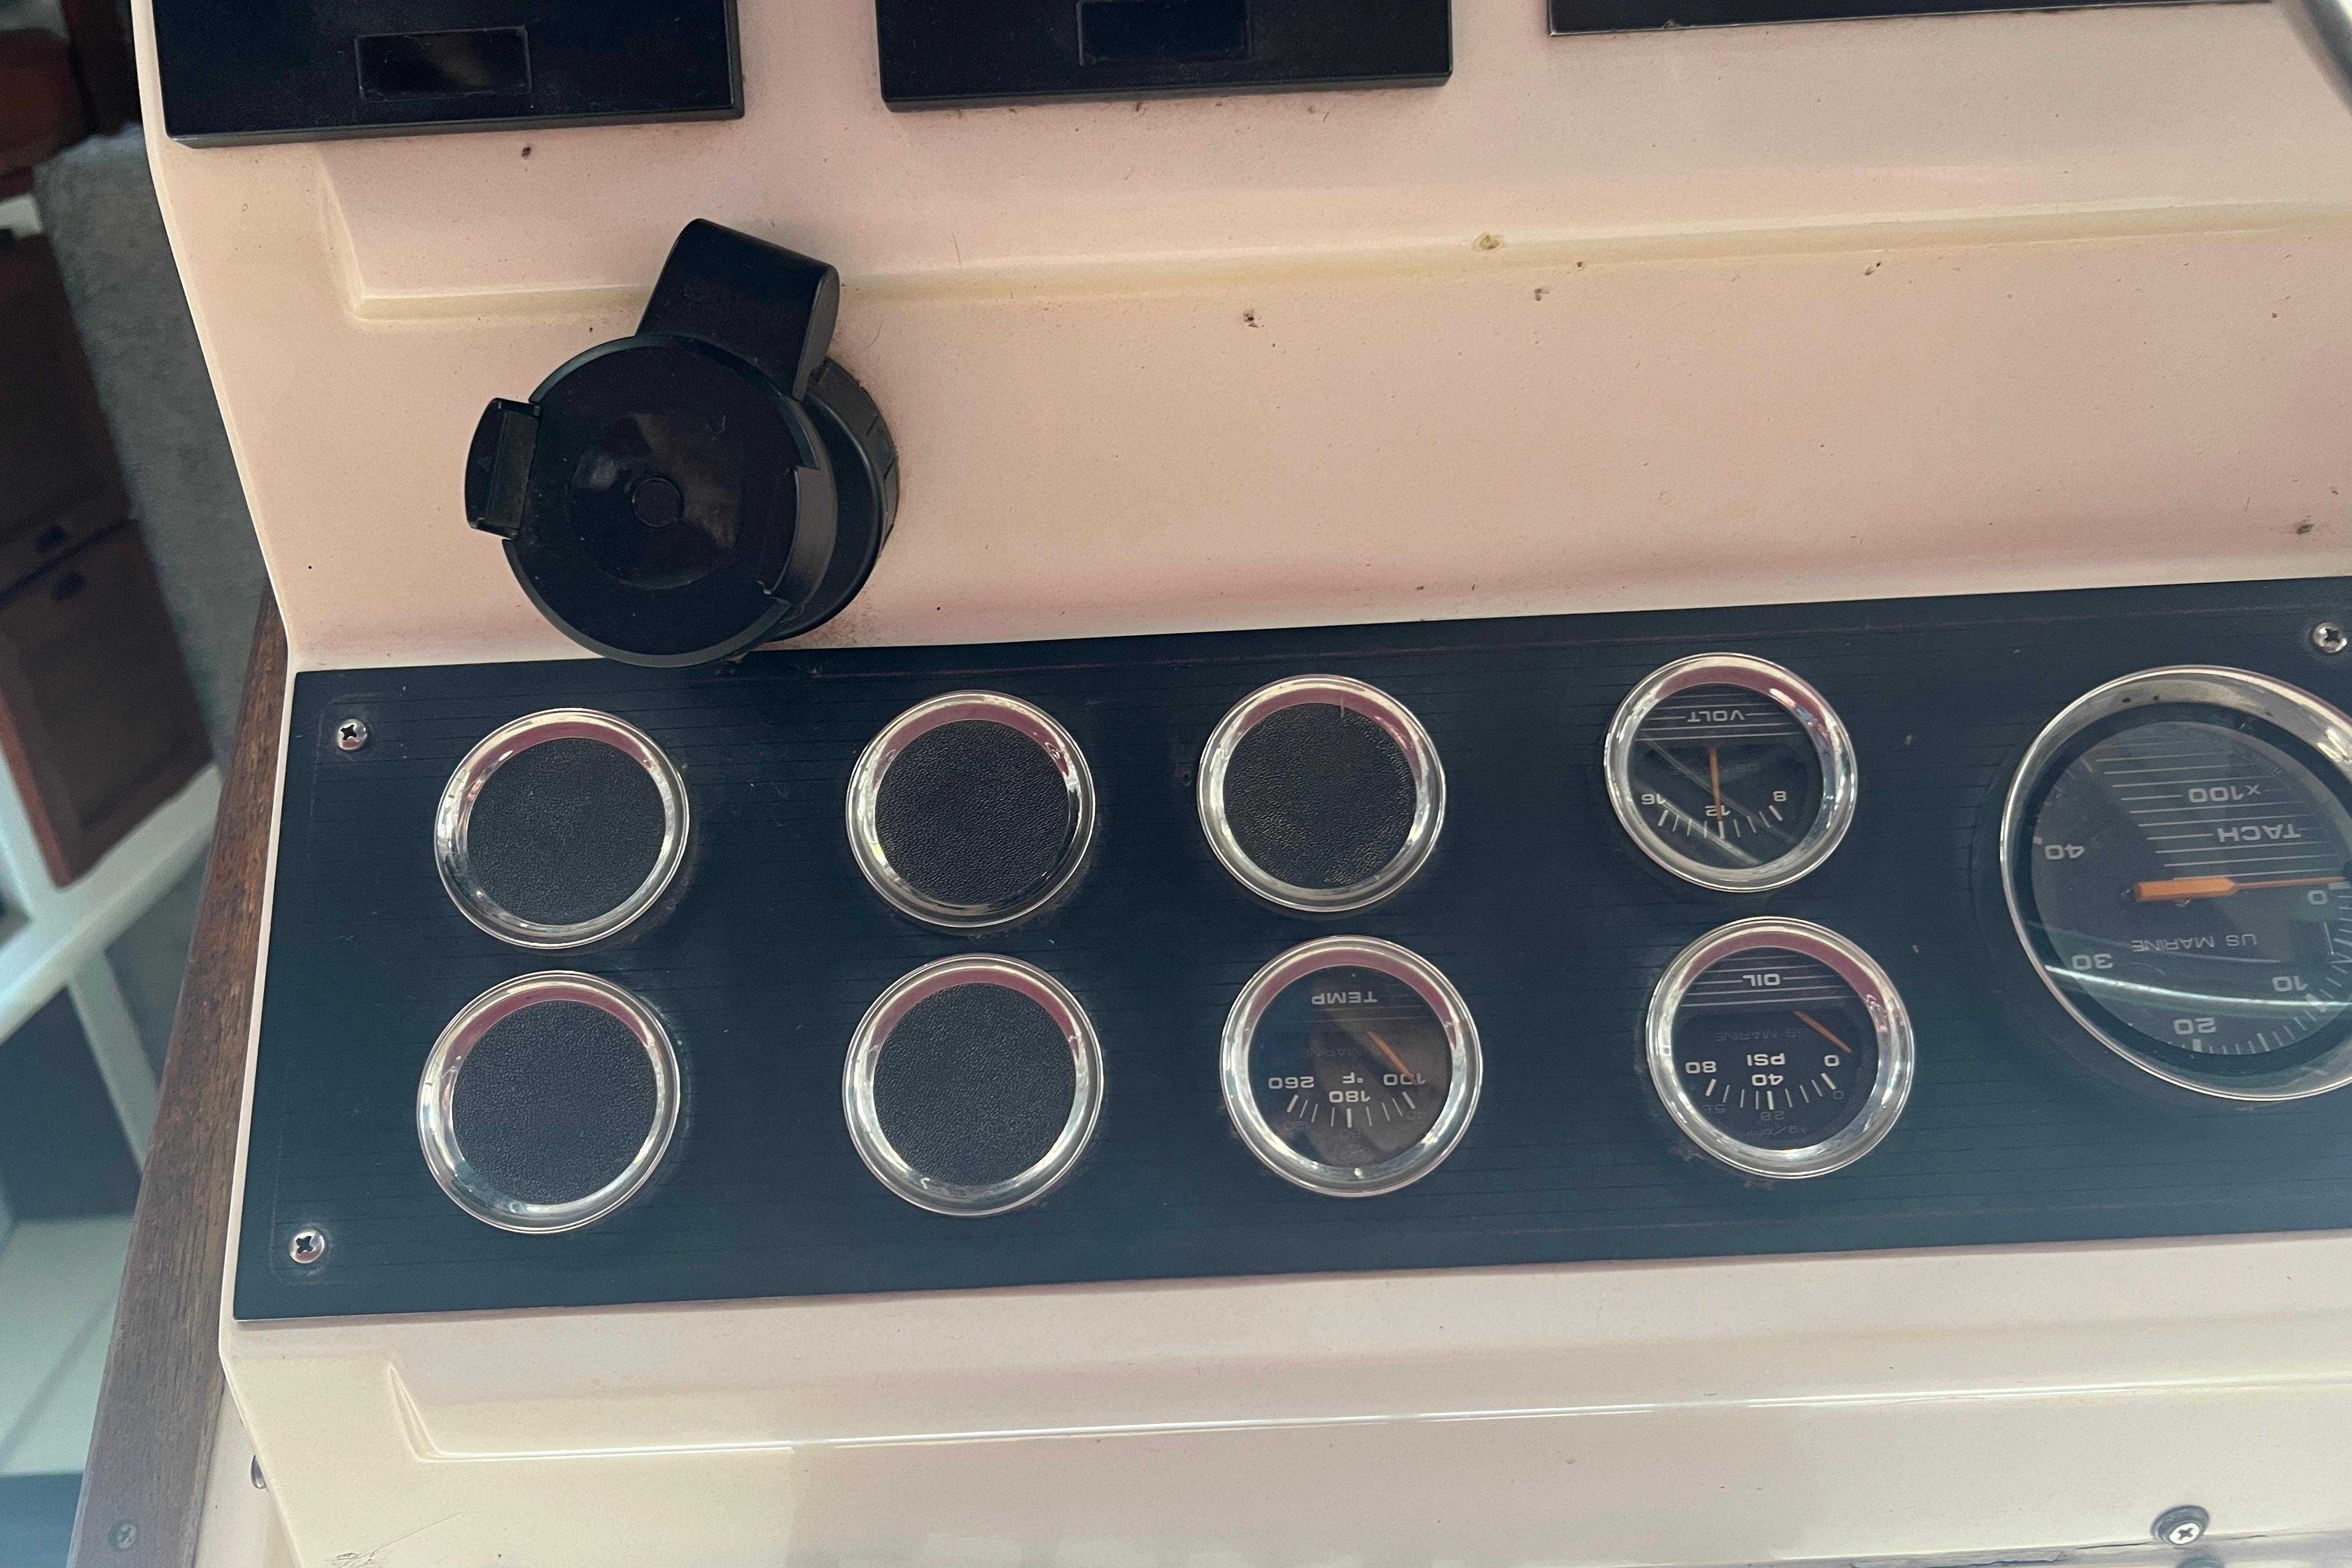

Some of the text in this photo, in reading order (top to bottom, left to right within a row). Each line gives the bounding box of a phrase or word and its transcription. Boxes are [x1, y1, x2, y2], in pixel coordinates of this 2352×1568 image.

[1686, 710, 1745, 723] VOLT
[1642, 793, 1666, 805] 16
[1773, 791, 1787, 802] 8
[1705, 805, 1731, 817] 12
[2218, 825, 2301, 842] TACH
[2045, 844, 2085, 860] 40
[2308, 890, 2329, 905] 0
[2132, 934, 2256, 952] US MARINE
[2071, 954, 2112, 970] 30
[1742, 974, 1780, 986] OIL
[2272, 975, 2308, 991] 10
[1311, 991, 1378, 1005] TEMP
[2174, 1018, 2217, 1035] 20
[1746, 1053, 1785, 1066] PSI
[1824, 1055, 1839, 1067] 0
[1685, 1061, 1716, 1073] 80
[1268, 1076, 1314, 1089] 260
[1383, 1073, 1426, 1086] 100
[1752, 1074, 1783, 1086] 40
[1328, 1090, 1370, 1102] 180
